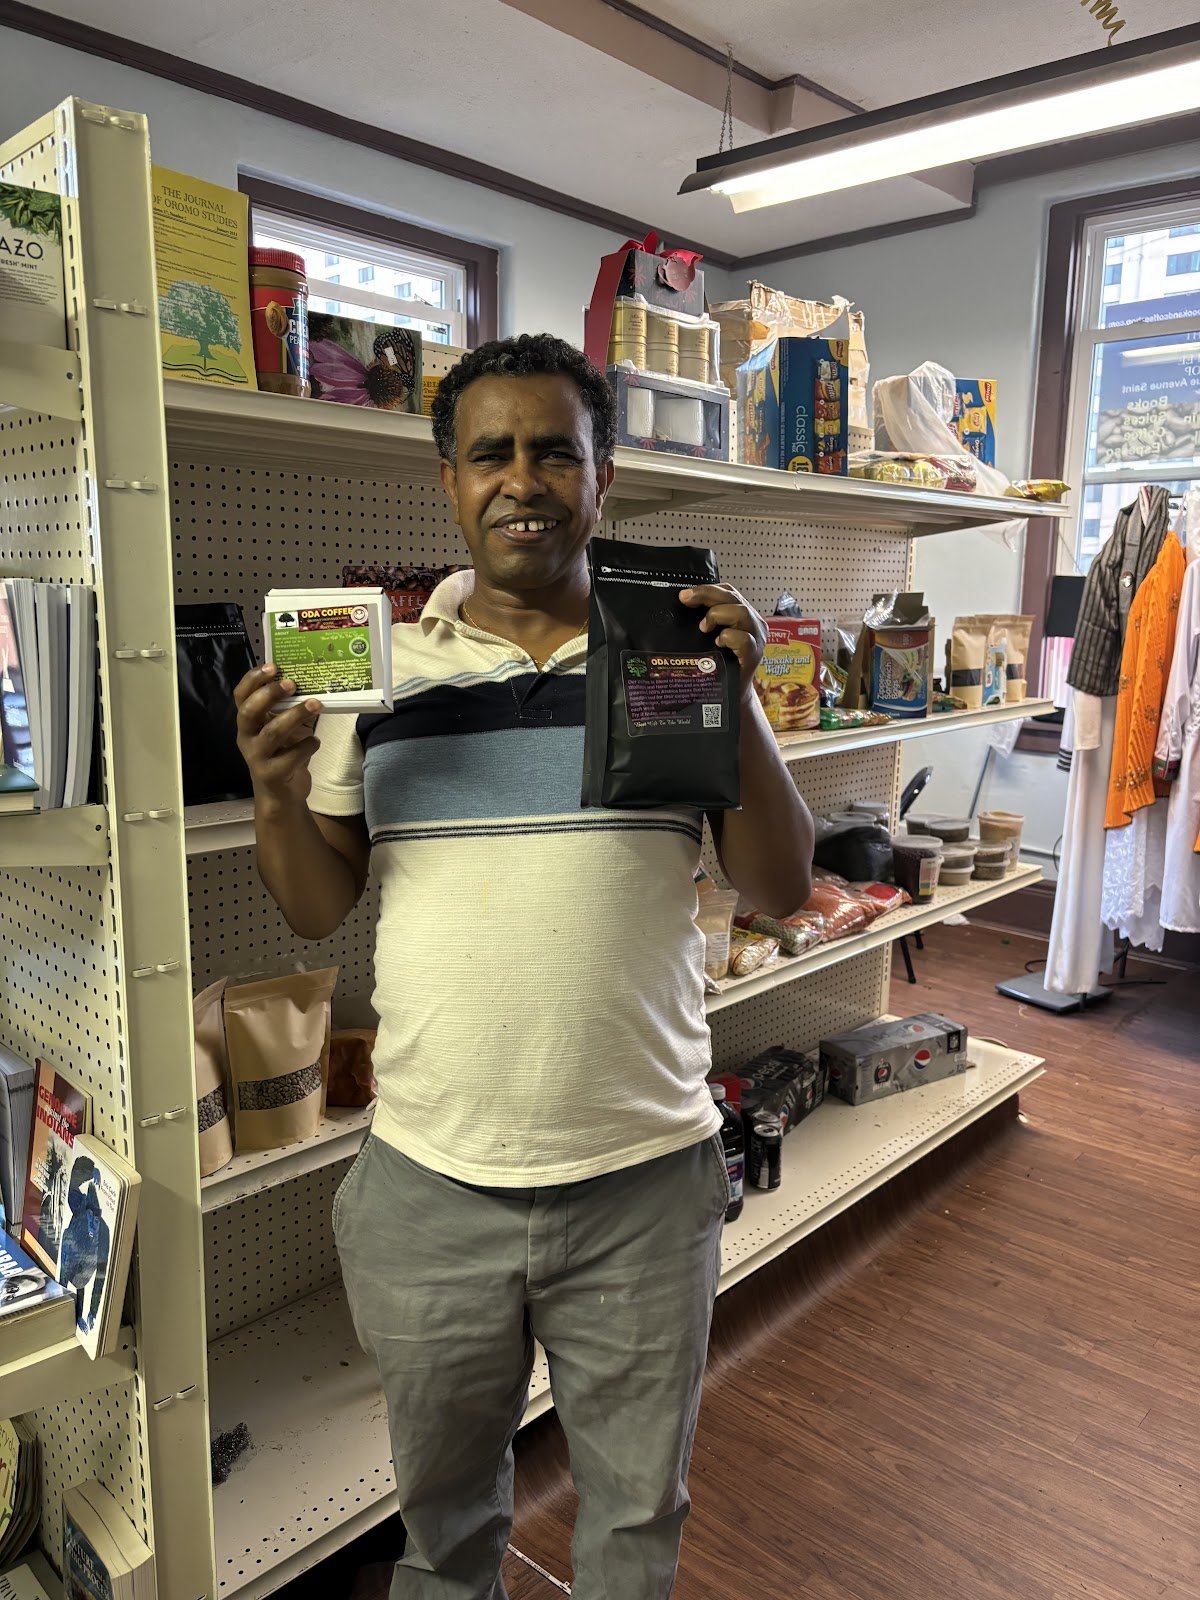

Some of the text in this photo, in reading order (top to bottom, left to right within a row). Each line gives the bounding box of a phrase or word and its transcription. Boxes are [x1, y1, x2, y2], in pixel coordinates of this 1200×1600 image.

[162, 186, 226, 214] THE JOURNAL
[165, 198, 199, 216] OROMO
[202, 211, 238, 228] STUDIES
[0, 236, 43, 259] AZO
[0, 259, 17, 267] RESH
[796, 405, 809, 453] classic
[391, 595, 423, 606] AFFE
[301, 607, 353, 618] ODA COFFEE
[651, 658, 699, 666] ODA COFFEE
[760, 654, 810, 665] Pancake and
[765, 664, 790, 676] Waffle
[877, 671, 885, 700] Zipper
[884, 662, 892, 700] Sandwich
[892, 680, 900, 700] Bags
[37, 1105, 75, 1149] INDIANS
